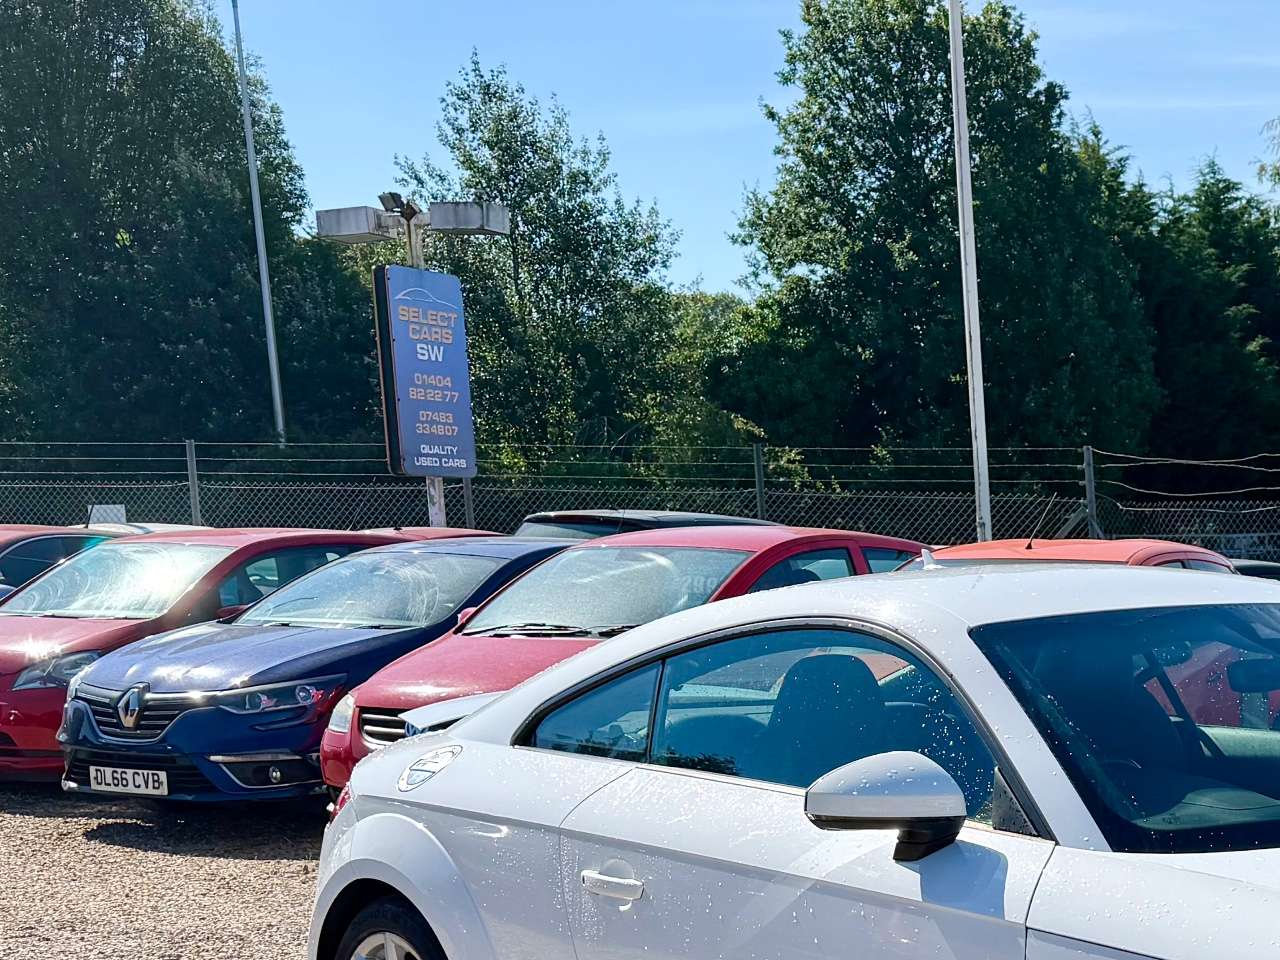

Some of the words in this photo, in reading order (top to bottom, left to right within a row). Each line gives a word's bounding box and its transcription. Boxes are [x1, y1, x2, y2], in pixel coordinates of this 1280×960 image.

[399, 305, 458, 328] SELECT
[409, 324, 453, 344] CARS
[416, 343, 444, 362] SW
[414, 373, 452, 388] 01404
[420, 444, 458, 455] QUALITY
[414, 457, 440, 467] USED
[441, 458, 467, 468] CARS
[95, 768, 129, 788] DL66
[132, 771, 161, 790] CVB
